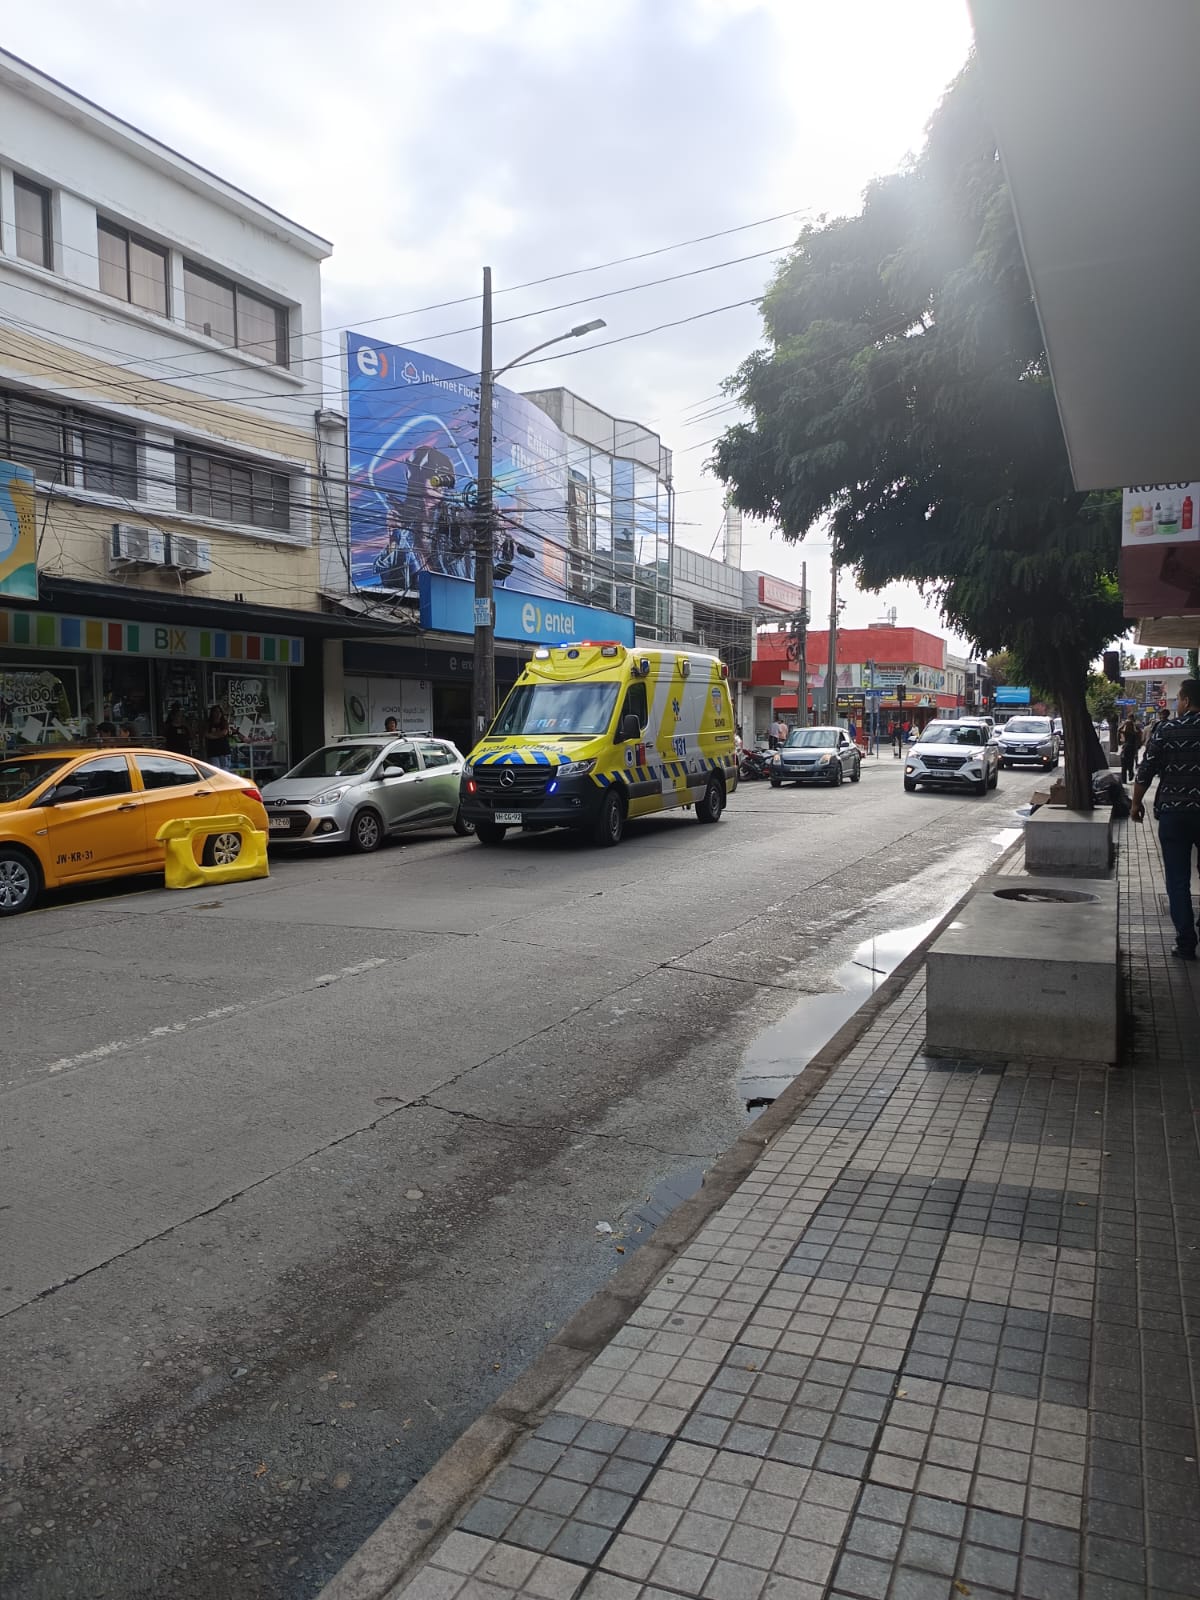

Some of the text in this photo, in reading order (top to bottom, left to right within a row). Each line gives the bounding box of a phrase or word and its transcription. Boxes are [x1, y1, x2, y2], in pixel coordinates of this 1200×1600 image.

[422, 370, 458, 393] Internet
[545, 612, 576, 635] entel
[675, 737, 687, 756] 131
